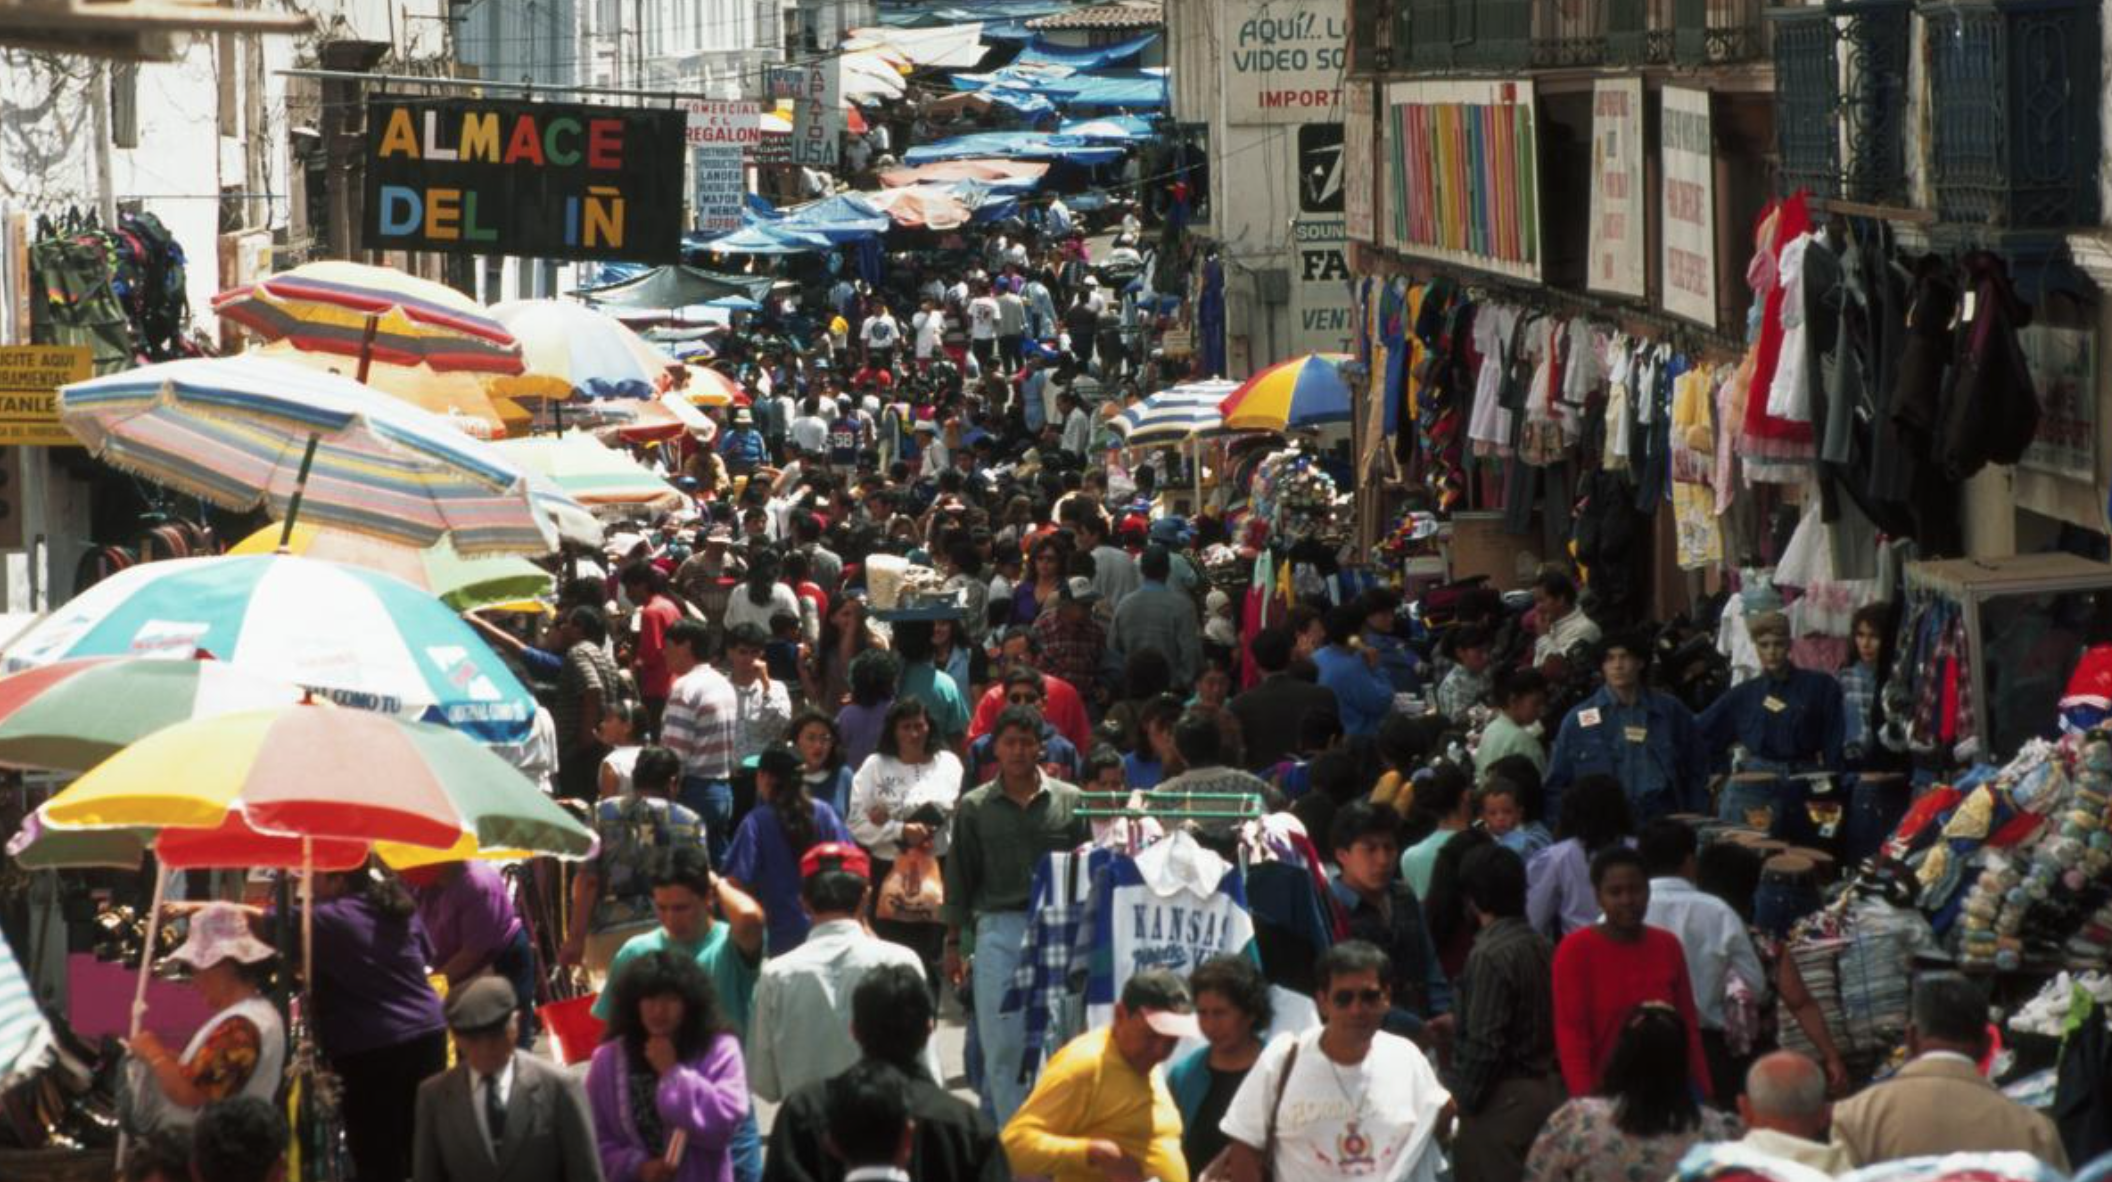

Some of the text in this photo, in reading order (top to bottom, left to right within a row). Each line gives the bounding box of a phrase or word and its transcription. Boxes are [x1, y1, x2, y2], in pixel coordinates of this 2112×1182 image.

[1327, 17, 1346, 39] L
[1232, 49, 1308, 73] VIDEO
[684, 103, 757, 114] COMERCIAL
[1259, 89, 1343, 108] IMPORT
[378, 107, 624, 169] ALMACE
[685, 127, 760, 142] REGALON
[794, 139, 835, 162] USA
[701, 170, 741, 180] LANDER
[703, 193, 739, 204] MAYOR
[379, 185, 626, 248] DEL IÑ
[1296, 223, 1344, 240] SOUN
[1301, 249, 1349, 281] FA
[41, 353, 76, 368] AQUI
[333, 689, 379, 711] COMO
